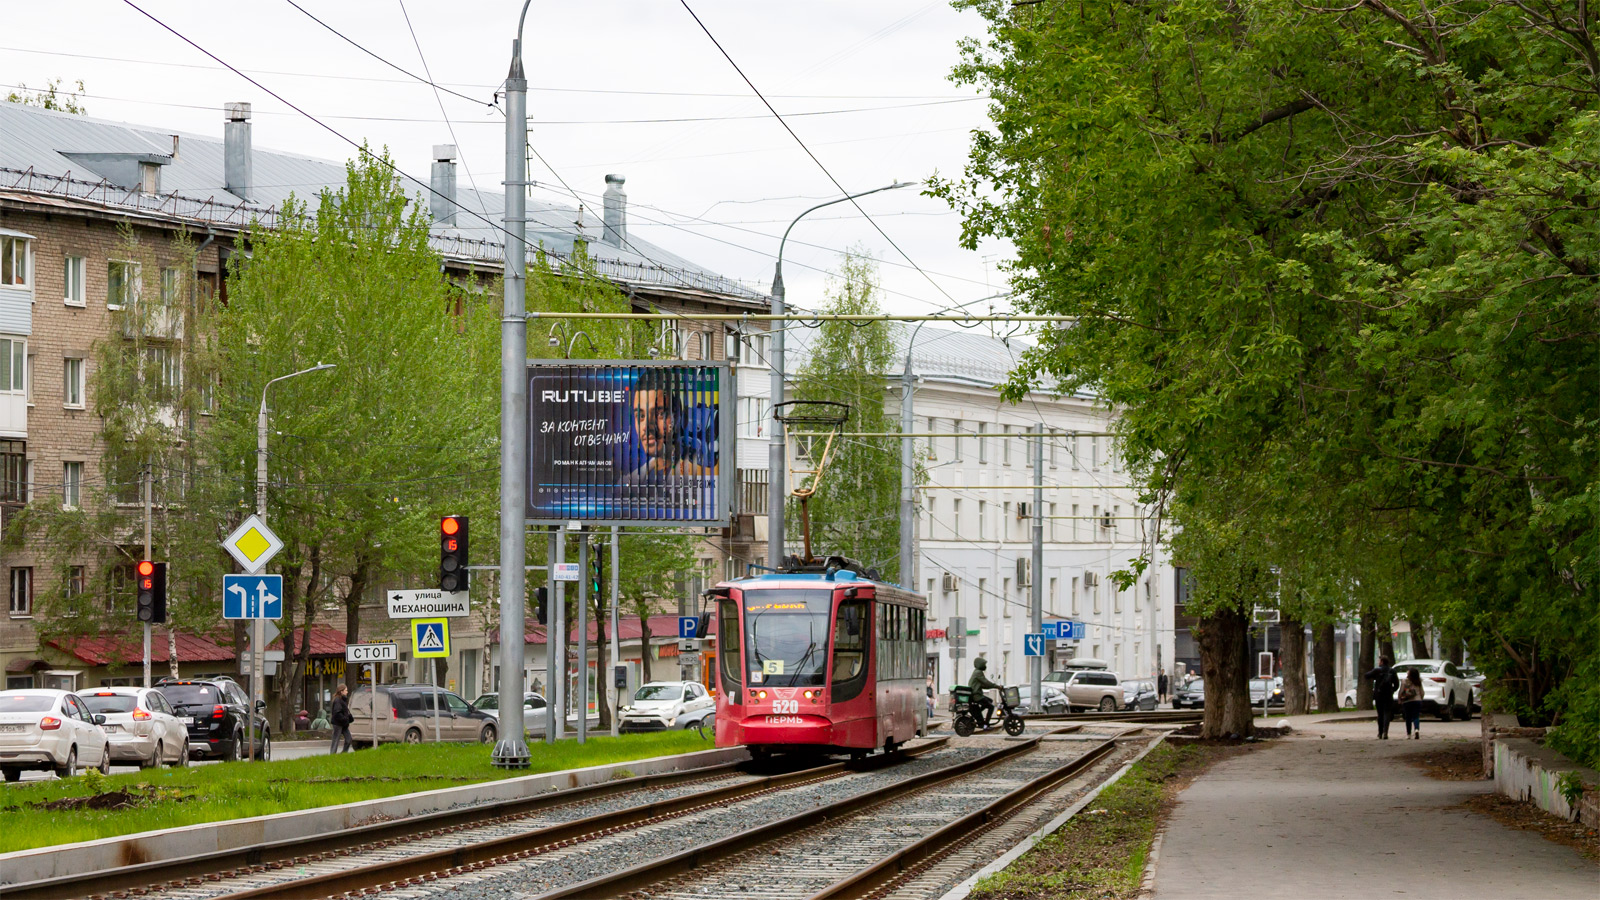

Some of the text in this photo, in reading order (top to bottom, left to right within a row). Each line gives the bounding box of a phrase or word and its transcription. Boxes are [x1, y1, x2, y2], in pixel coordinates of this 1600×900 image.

[542, 390, 625, 402] RUTUBE
[540, 419, 608, 433] ЗА КОНТЕНТ
[574, 431, 630, 447] ОТВЕЧАЮ!
[415, 592, 442, 600] улица
[392, 603, 464, 613] МЕХАНОШИНА
[353, 647, 390, 659] СТОП
[768, 662, 777, 673] 5
[772, 700, 798, 714] 520
[765, 715, 803, 724] ПЕРМЬ
